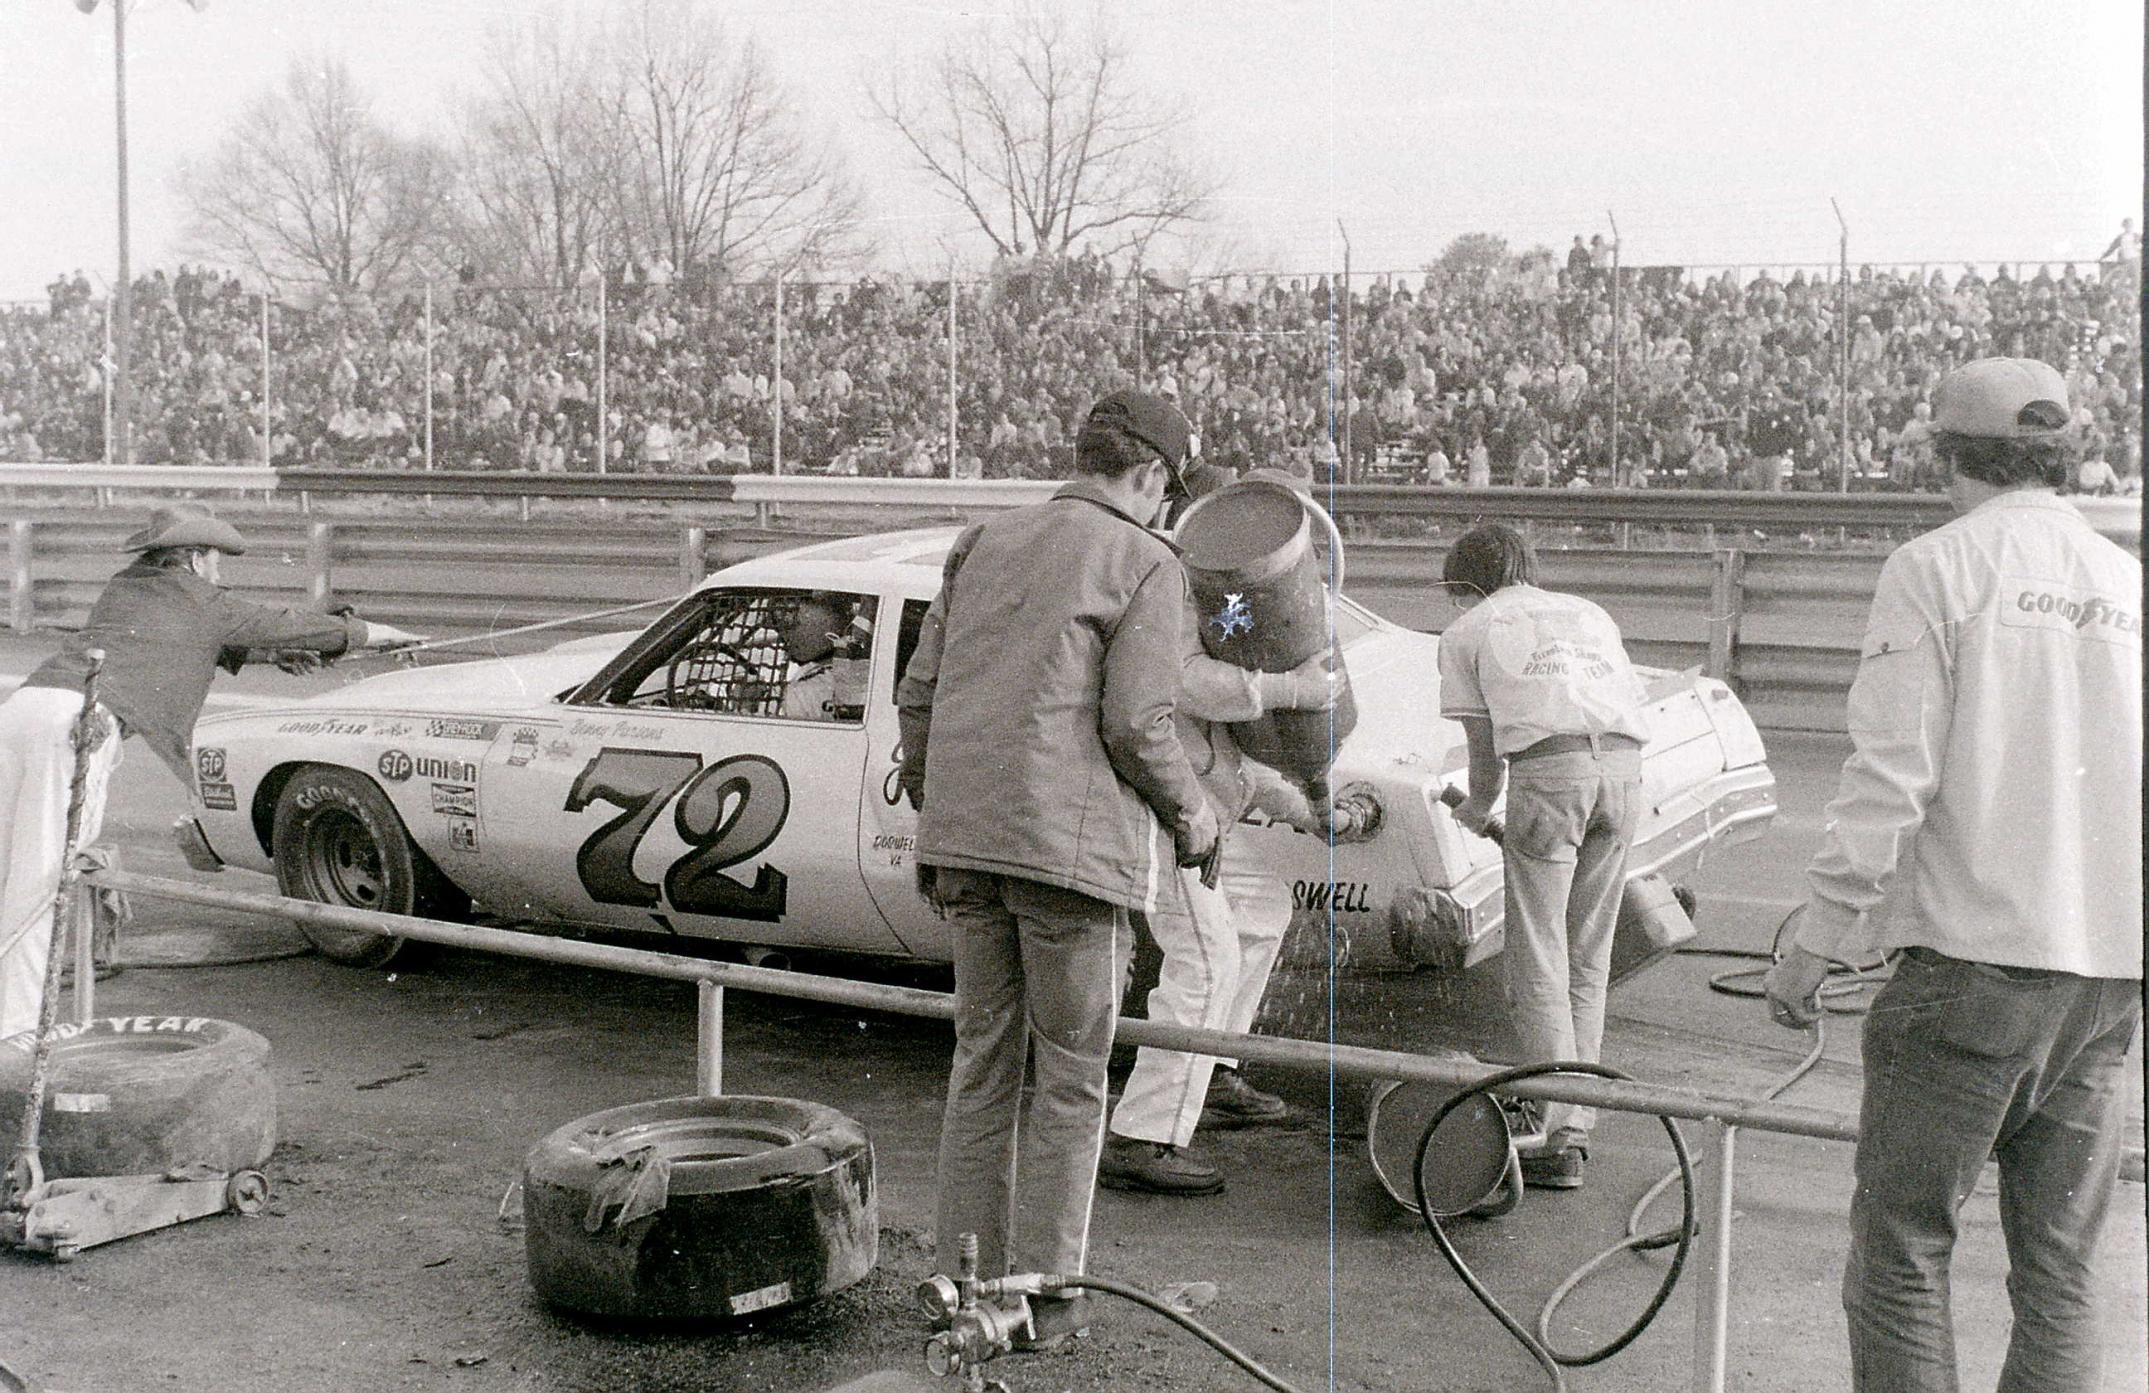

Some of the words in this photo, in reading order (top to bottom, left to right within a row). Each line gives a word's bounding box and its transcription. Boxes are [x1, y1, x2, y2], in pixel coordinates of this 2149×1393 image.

[2017, 591, 2140, 632] GOODYEA
[1521, 661, 1569, 676] RACING
[1583, 659, 1615, 679] TEAM
[278, 719, 368, 736] GOODYEAR
[200, 751, 222, 775] STP
[381, 752, 410, 778] STP
[563, 746, 790, 923] 72
[890, 855, 902, 866] VA
[1292, 880, 1371, 913] SWELL
[108, 1016, 210, 1033] YEAR
